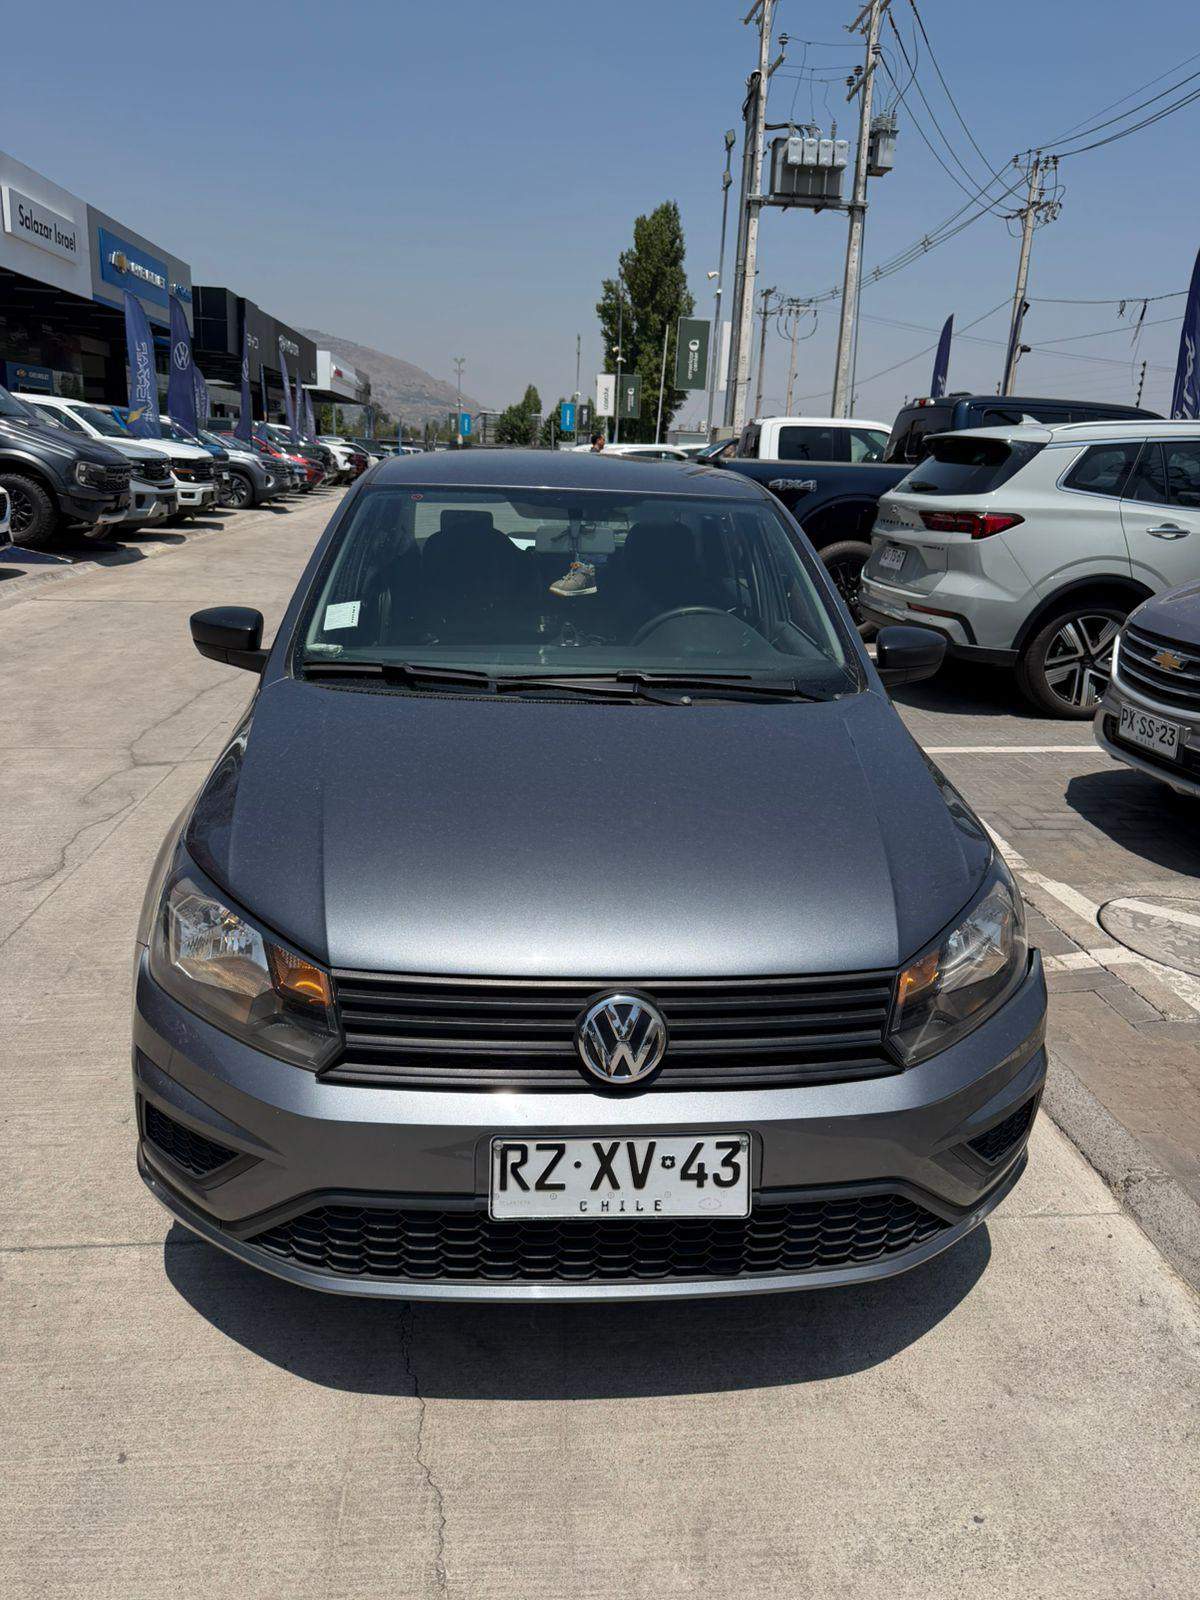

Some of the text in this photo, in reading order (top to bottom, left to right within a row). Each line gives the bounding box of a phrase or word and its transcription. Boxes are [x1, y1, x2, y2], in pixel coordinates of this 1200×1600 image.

[18, 204, 77, 253] Salazar Israel
[579, 1199, 663, 1212] CHILE
